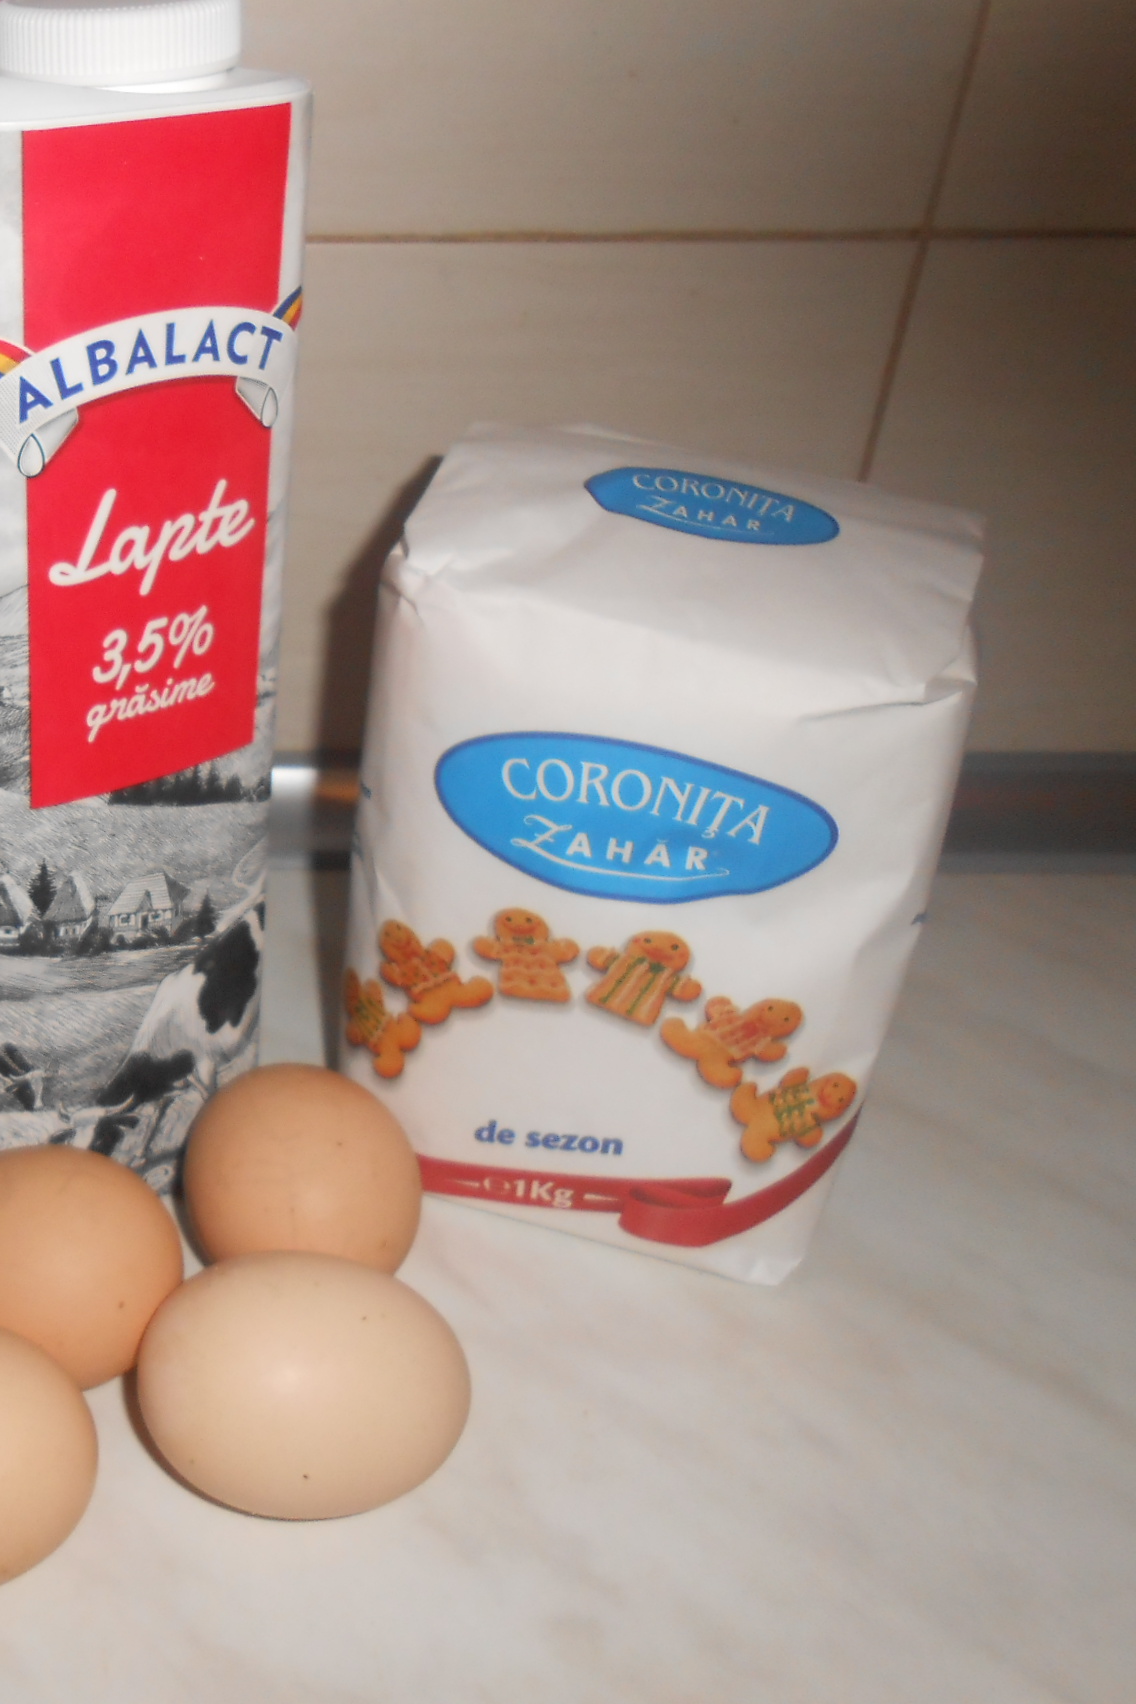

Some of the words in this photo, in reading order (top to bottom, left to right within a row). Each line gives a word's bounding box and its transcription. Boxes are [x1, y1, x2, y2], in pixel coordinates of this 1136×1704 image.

[17, 319, 284, 424] ALBALACT
[47, 478, 256, 597] Lapte
[92, 604, 215, 691] 3,5%
[85, 672, 216, 743] grăsime
[474, 1120, 516, 1146] de
[524, 1130, 624, 1155] sezon
